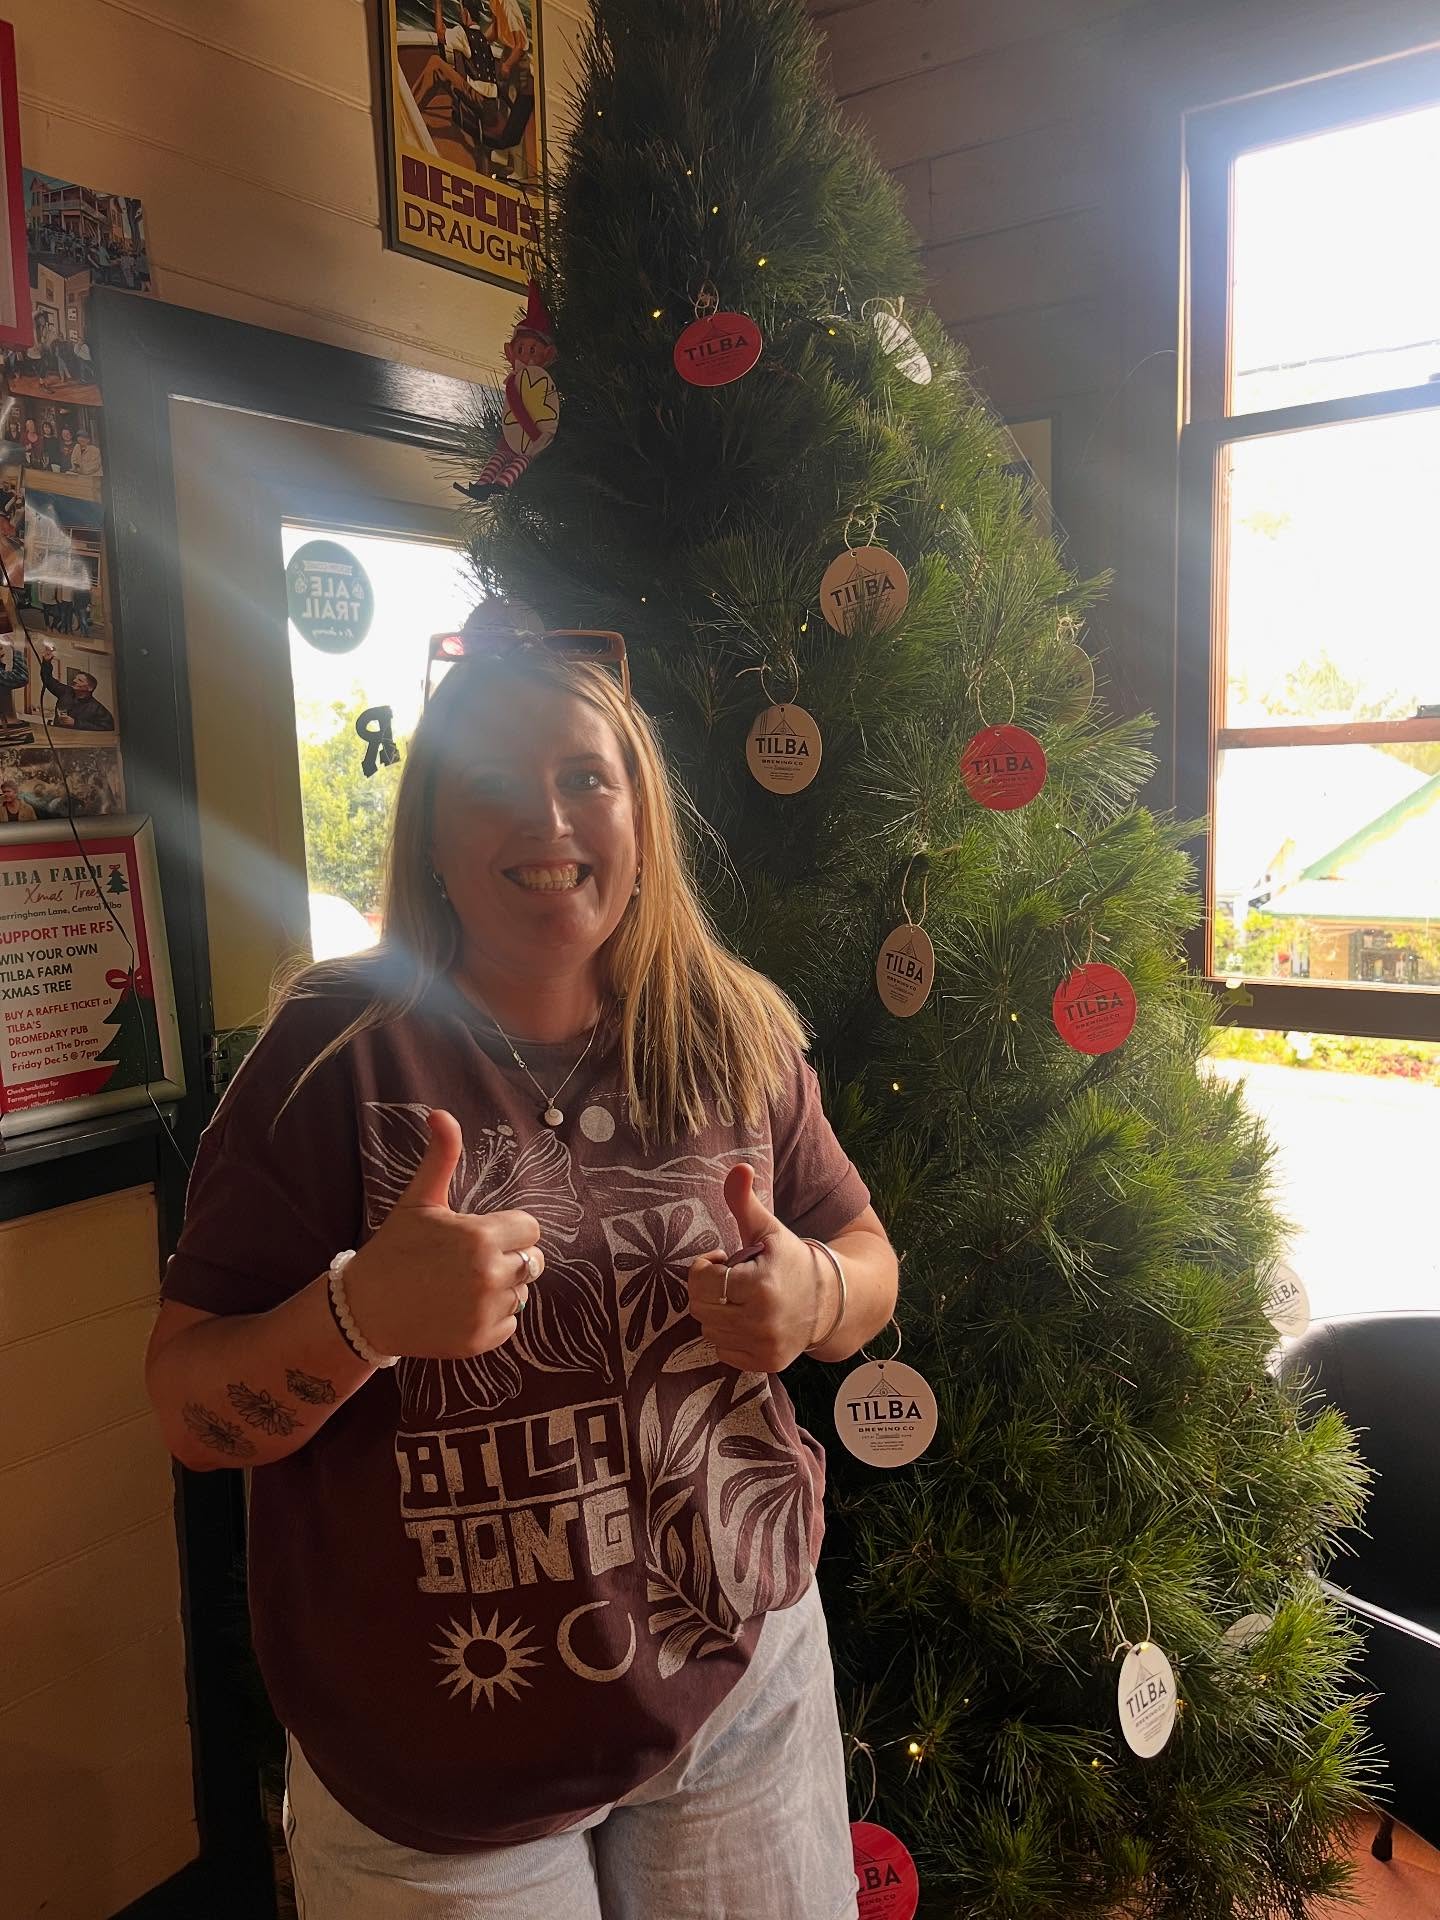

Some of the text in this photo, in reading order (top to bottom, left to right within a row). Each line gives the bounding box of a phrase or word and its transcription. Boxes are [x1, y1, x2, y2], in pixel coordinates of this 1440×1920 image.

[684, 335, 749, 361] TILBA
[755, 737, 809, 757] TILBA
[971, 755, 1034, 776] TILBA
[72, 903, 101, 913] Central
[62, 923, 87, 938] THE
[90, 920, 114, 935] RFS
[0, 943, 98, 966] WIN YOUR OWN
[0, 962, 73, 983] TILBA FARM
[885, 952, 923, 985] TILBA
[2, 979, 72, 1001] XMAS TREE
[5, 997, 113, 1022] BUY A RAFFLE TICKET at
[1063, 991, 1125, 1021] TILBA
[7, 1020, 42, 1034] TILBA'S
[8, 1025, 89, 1047] DROMEDARY PUB
[10, 1037, 99, 1059] Drawn at The Drom
[12, 1059, 42, 1073] Friday
[44, 1055, 61, 1066] Dec
[62, 1053, 69, 1062] 5
[80, 1049, 101, 1060] 7pm
[846, 1400, 923, 1422] TILBA
[858, 1426, 901, 1434] BREWING
[404, 1486, 635, 1594] BONG
[1126, 1677, 1168, 1718] TILBA
